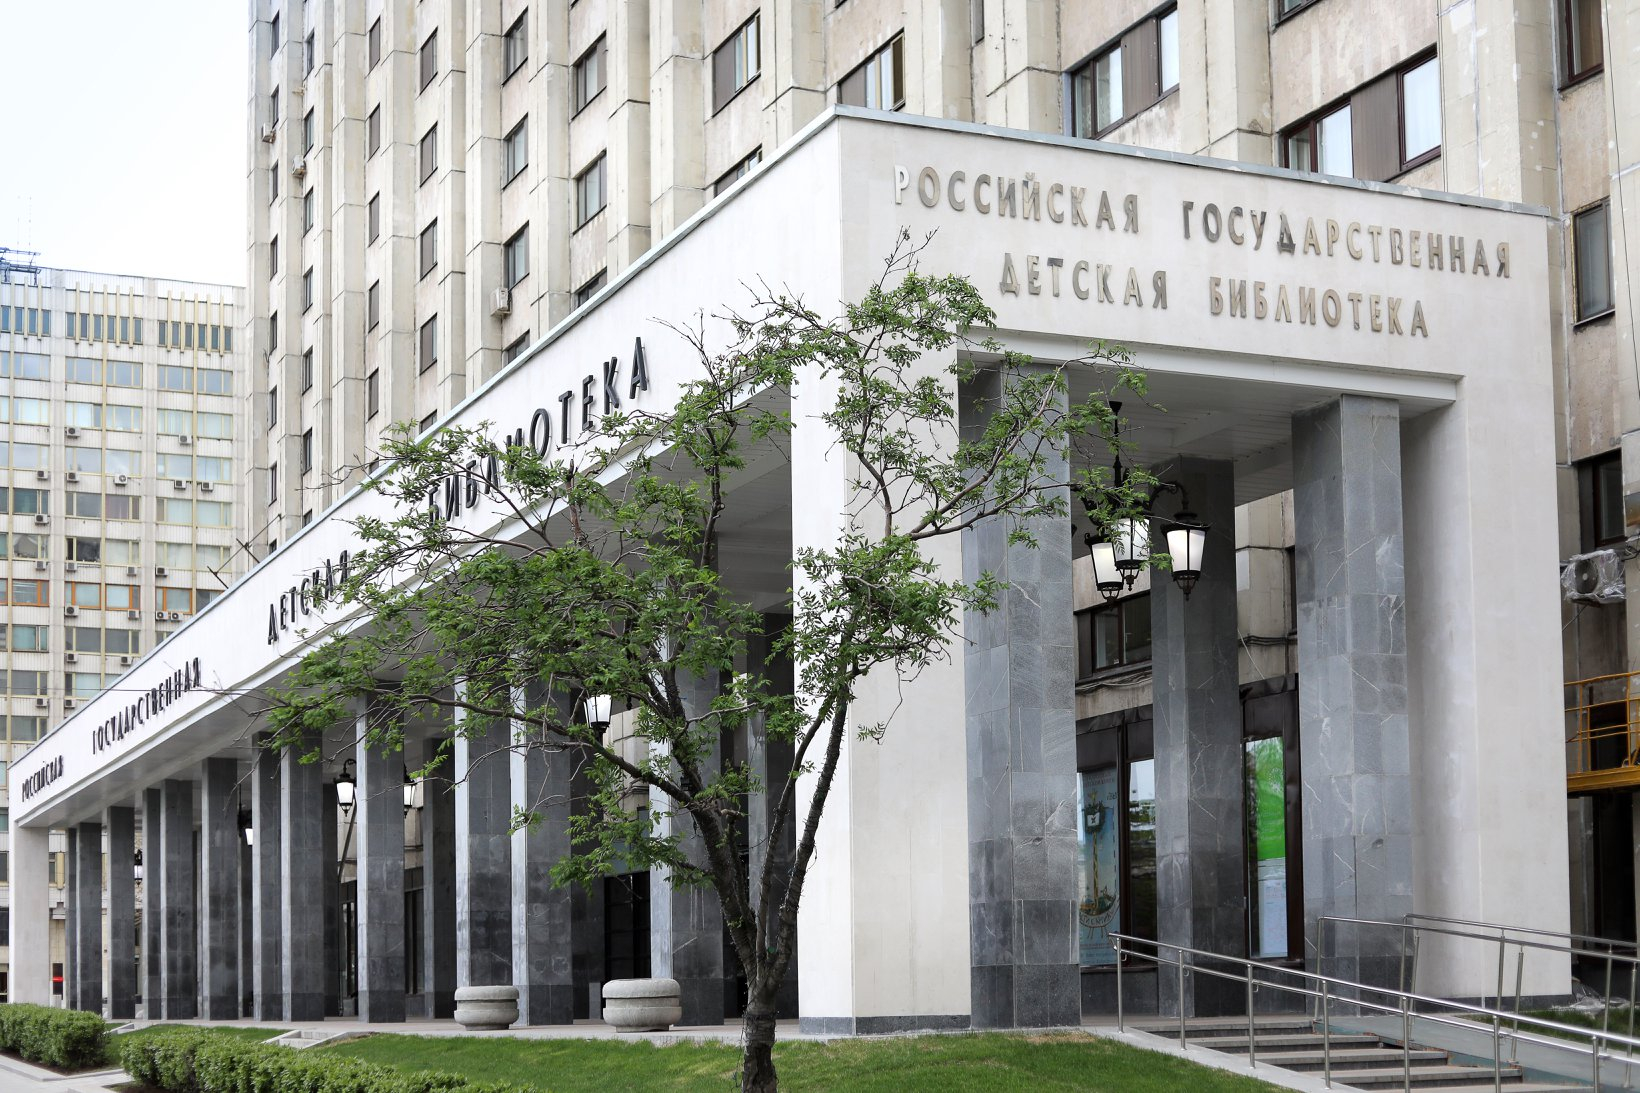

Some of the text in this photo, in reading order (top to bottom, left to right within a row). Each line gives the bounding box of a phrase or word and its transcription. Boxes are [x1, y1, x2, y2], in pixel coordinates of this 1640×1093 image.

[894, 165, 1510, 278] РОССИЙСКАЯ ГОСУДАРСТВЕННАЯ
[1000, 252, 1428, 337] ДЕТСКАЯ БИБЛИОТЕКА
[92, 657, 201, 754] ГОСУДАРСТВЕННАЯ
[268, 550, 348, 645] ДЕТСКАЯ
